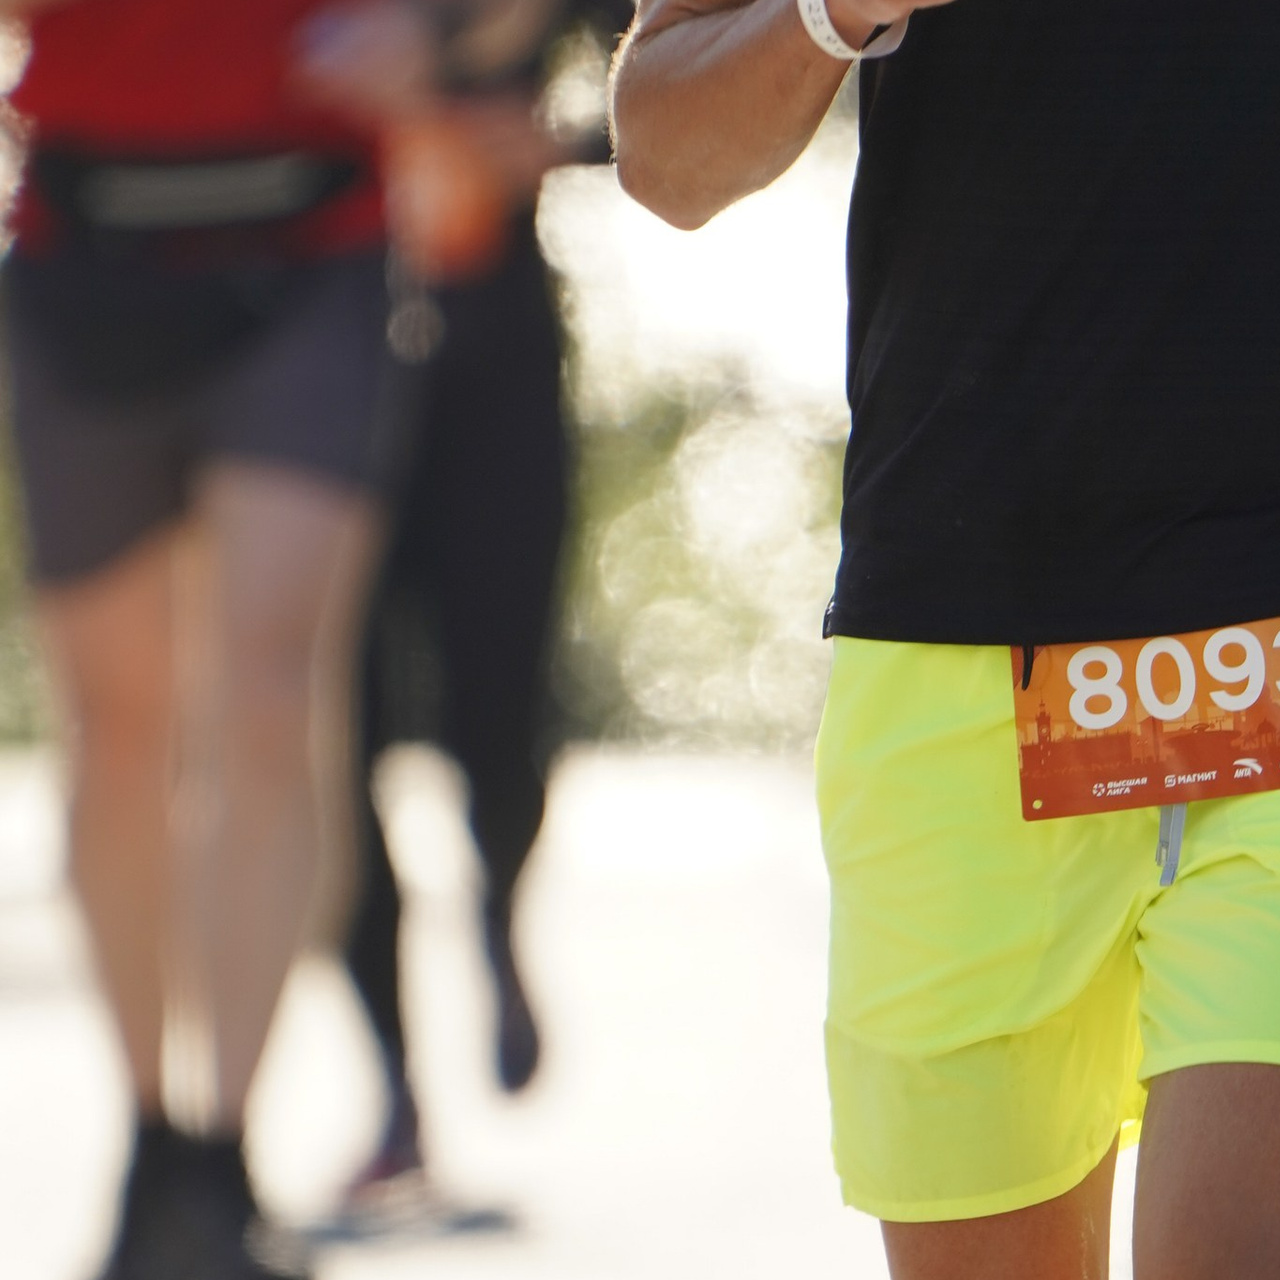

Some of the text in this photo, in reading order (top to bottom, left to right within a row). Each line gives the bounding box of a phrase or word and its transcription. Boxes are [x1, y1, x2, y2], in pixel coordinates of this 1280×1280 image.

[1106, 777, 1148, 790] ВЫСШАЯ
[1177, 770, 1218, 786] МАГНИТ
[1106, 786, 1131, 797] ЛИГА
